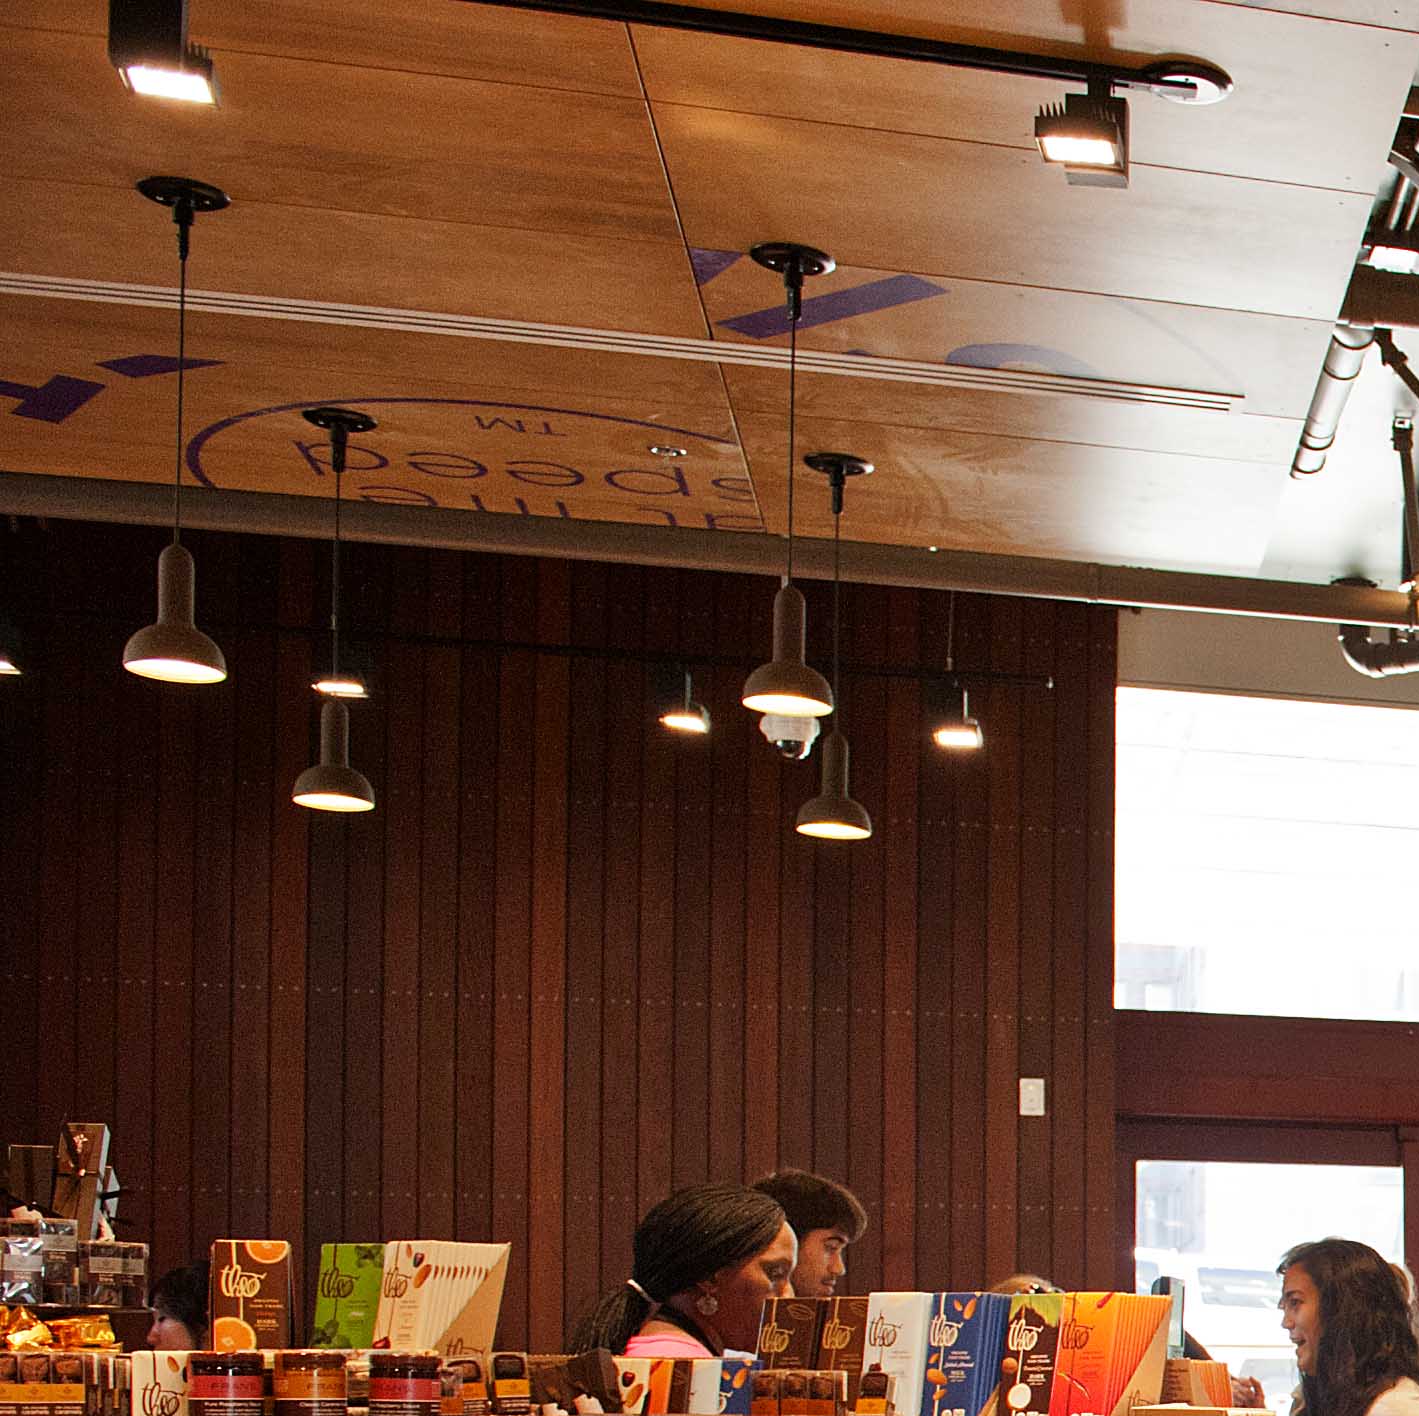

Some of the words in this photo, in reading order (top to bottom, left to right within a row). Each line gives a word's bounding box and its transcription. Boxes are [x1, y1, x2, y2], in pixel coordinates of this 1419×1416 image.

[474, 415, 566, 437] TM
[293, 438, 756, 500] speed
[221, 1264, 267, 1298] theo
[321, 1266, 360, 1298] theo
[383, 1267, 413, 1298] theo
[760, 1321, 796, 1352] theo
[822, 1318, 856, 1350] theo
[868, 1315, 903, 1347] theo
[929, 1314, 964, 1347] theo
[1008, 1318, 1044, 1351] theo
[1060, 1318, 1094, 1349] theo
[140, 1382, 186, 1416] theo
